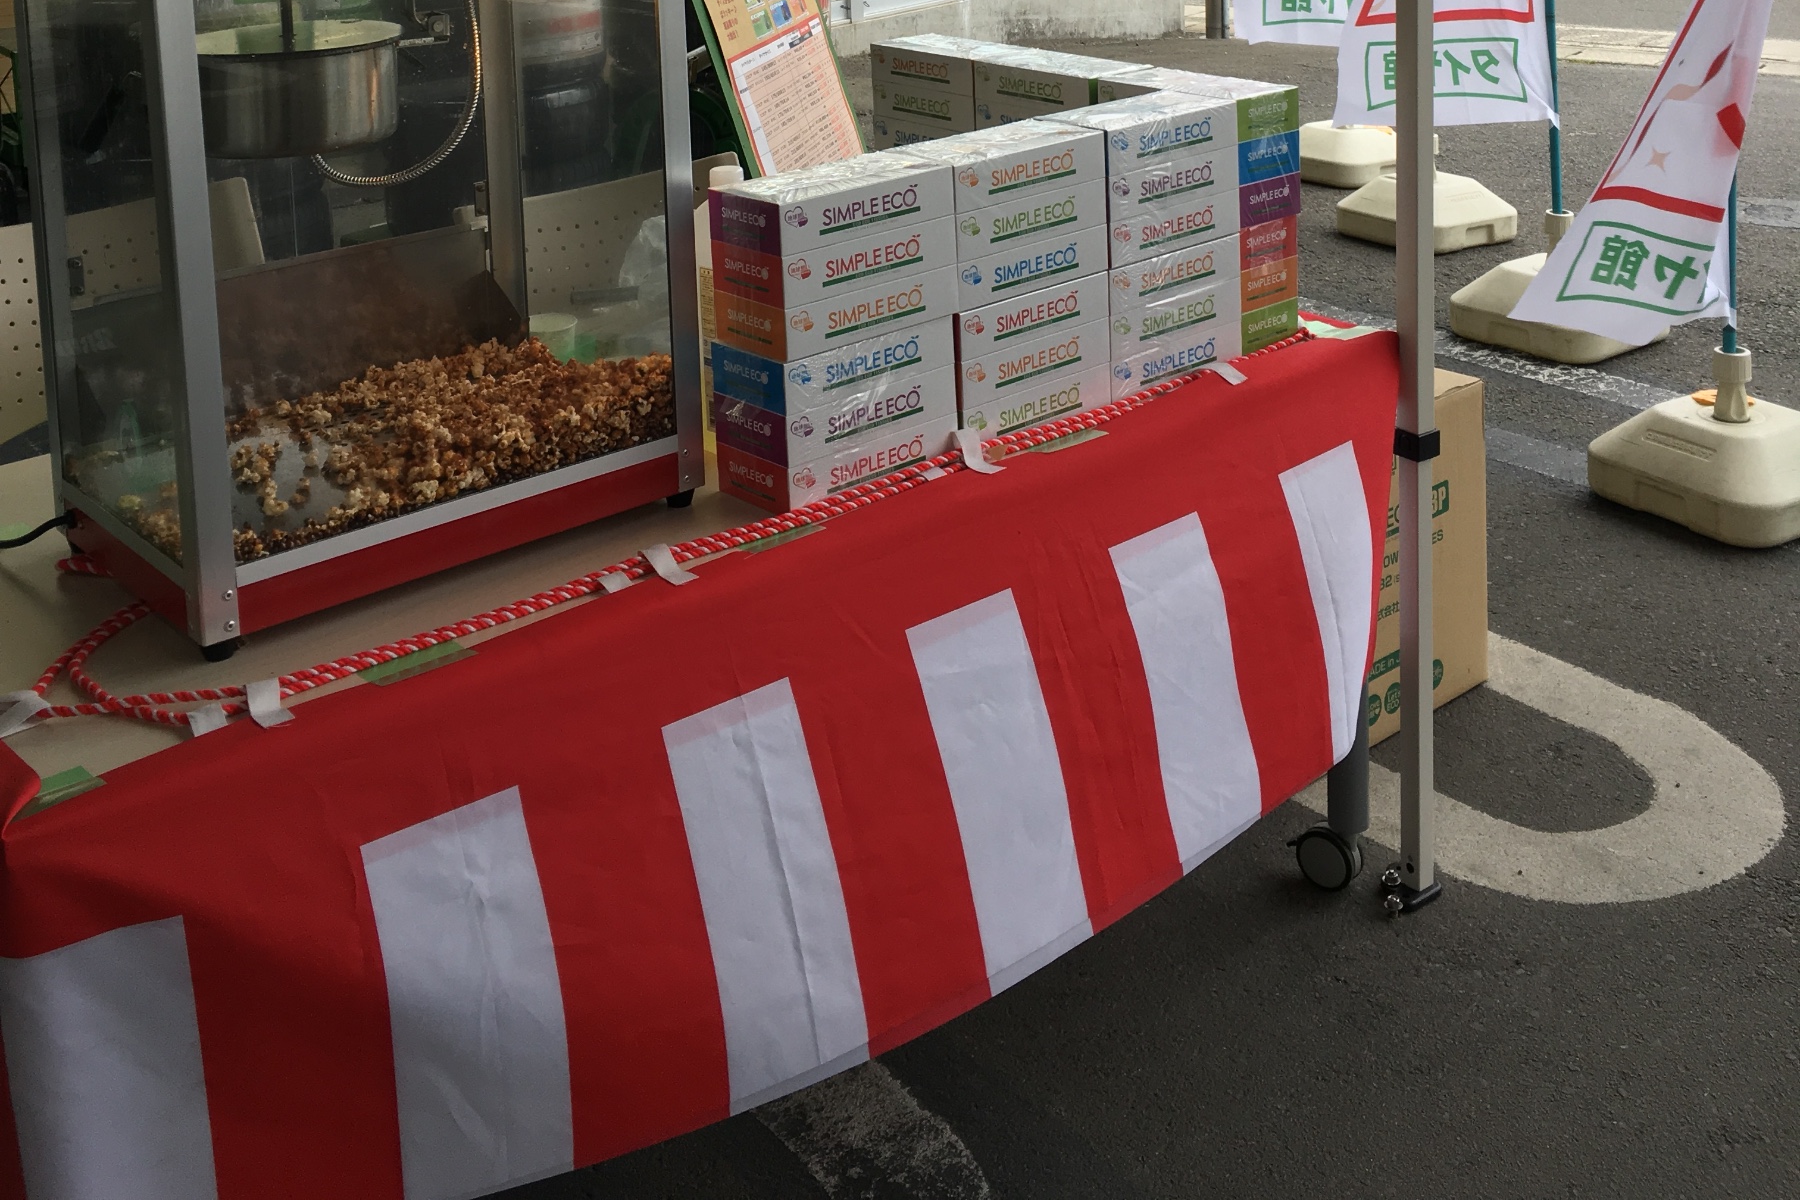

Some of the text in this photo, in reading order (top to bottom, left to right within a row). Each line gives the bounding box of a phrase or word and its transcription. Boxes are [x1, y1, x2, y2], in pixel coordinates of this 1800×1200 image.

[998, 76, 1036, 94] SIMPLE
[1139, 126, 1182, 151] SIMPLE
[991, 160, 1040, 187] SIMPLE
[1140, 171, 1183, 196] SIMPLE
[822, 196, 879, 227] SIMPLE
[882, 186, 918, 212] ECO
[993, 207, 1041, 235] SIMPLE
[1141, 216, 1184, 242] SIMPLE
[825, 247, 882, 278] SIMPLE
[884, 236, 921, 262] ECO
[994, 255, 1043, 284] SIMPLE
[1141, 263, 1184, 289] SIMPLE
[828, 298, 885, 330] SIMPLE
[887, 286, 923, 313] ECO
[996, 303, 1045, 333] SIMPLE
[1141, 307, 1185, 333] SIMPLE
[826, 350, 881, 383] SIMPLE
[998, 350, 1047, 380] SIMPLE
[1142, 351, 1186, 378] SIMPLE
[828, 401, 883, 434] SIMPLE
[1000, 396, 1048, 428] SIMPLE
[830, 450, 886, 485] SIMPLE
